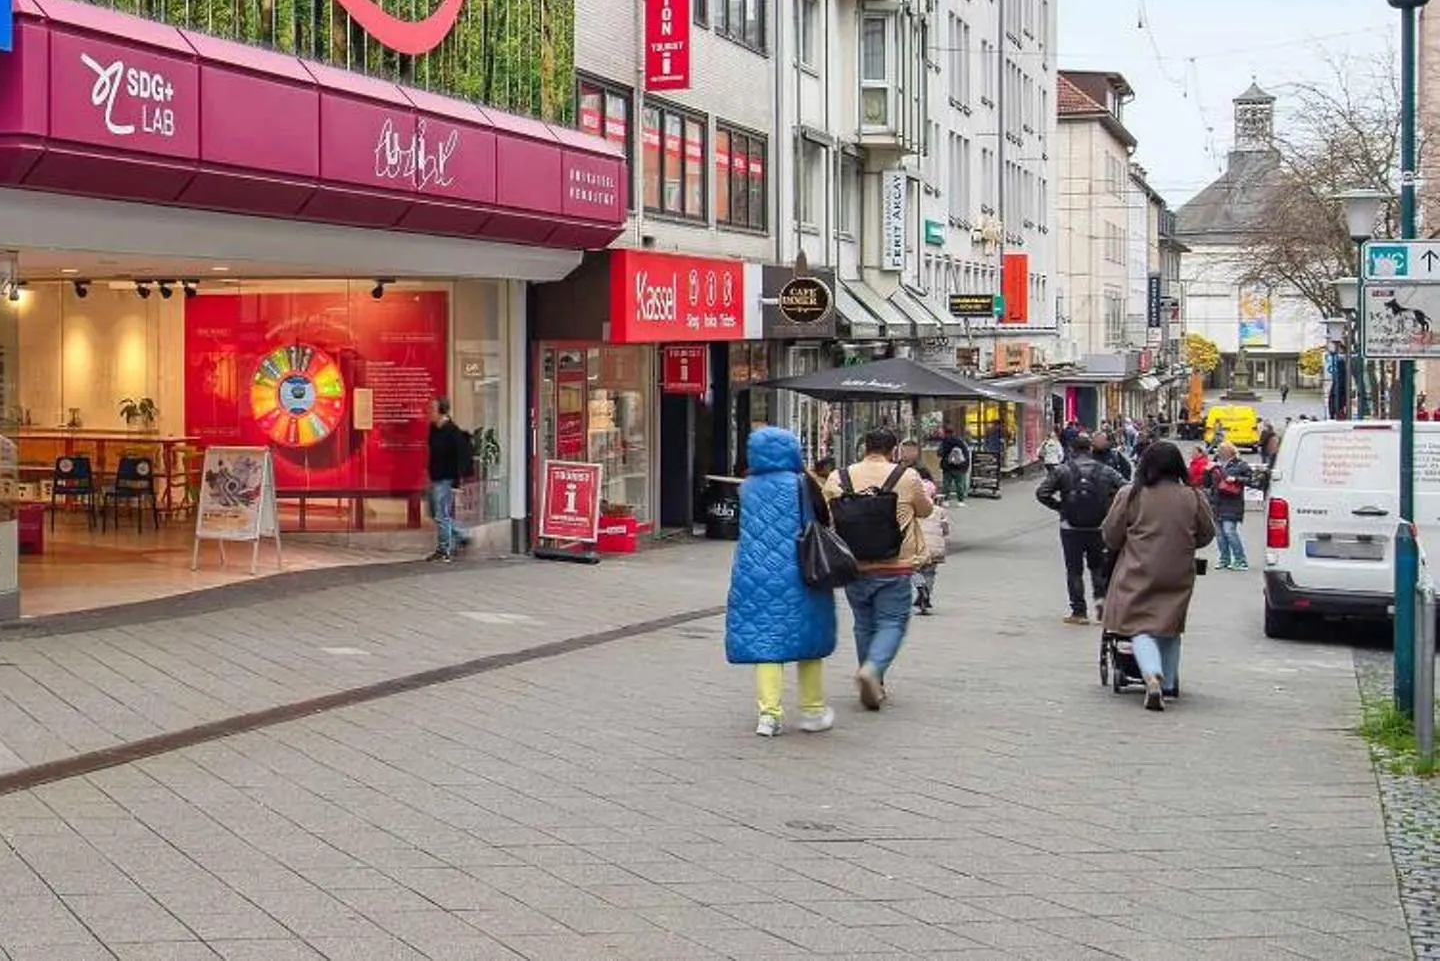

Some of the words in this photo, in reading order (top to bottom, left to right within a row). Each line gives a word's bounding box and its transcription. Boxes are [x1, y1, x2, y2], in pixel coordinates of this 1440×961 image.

[127, 68, 174, 101] SDG+
[143, 105, 174, 136] LAB
[636, 270, 677, 322] Kassel
